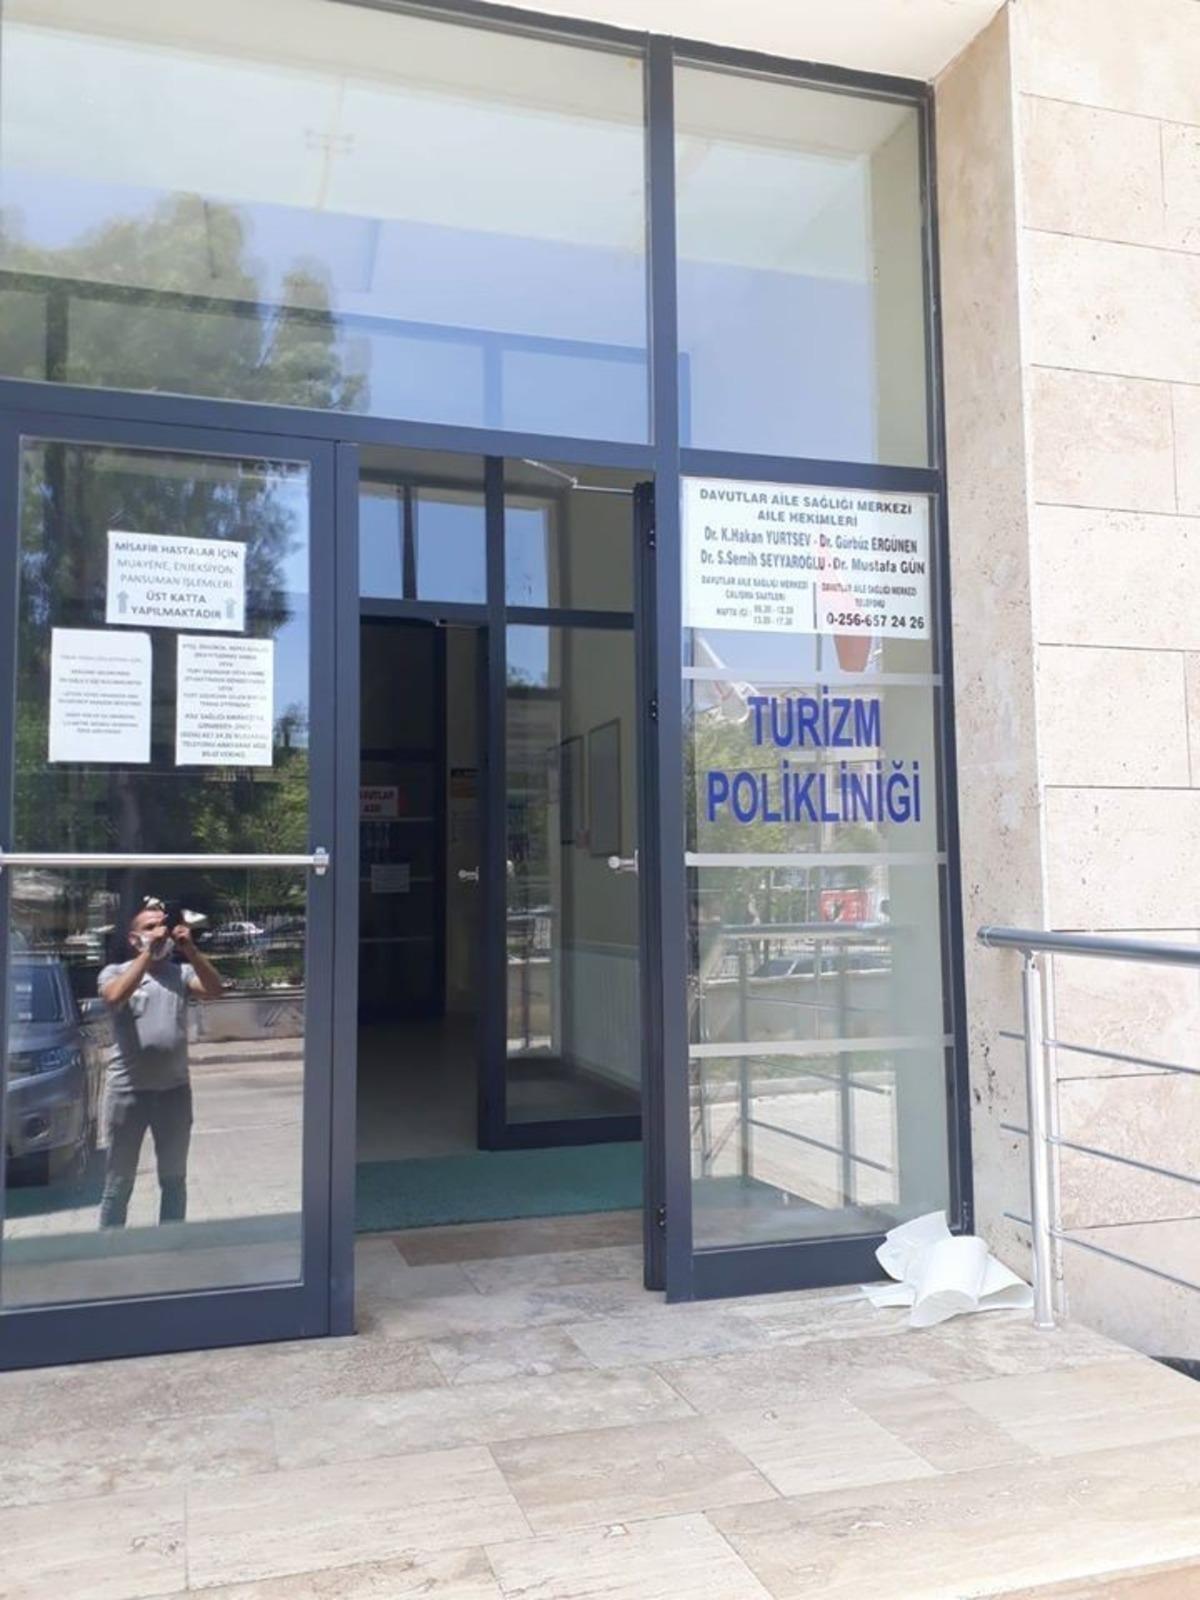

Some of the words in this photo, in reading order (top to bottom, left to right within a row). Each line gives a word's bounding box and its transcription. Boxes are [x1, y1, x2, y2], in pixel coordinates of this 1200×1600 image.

[700, 488, 767, 504] DAVUTLAR
[771, 490, 799, 506] AİLE
[804, 493, 854, 510] SAĞLIĞI
[757, 509, 784, 522] AİLE
[789, 511, 858, 527] HEKİMLERİ
[115, 540, 158, 552] MİSAFİR
[161, 545, 215, 557] HASTALAR
[218, 547, 239, 560] İÇİN
[705, 526, 718, 541] Dr.
[721, 527, 763, 544] K.Hakan
[766, 529, 811, 547] YURTSEV
[819, 533, 833, 549] Dr.
[835, 533, 870, 551] Gürbüz
[871, 534, 918, 554] ERGÜNEN
[701, 549, 714, 564] Dr.
[717, 550, 758, 567] S.Semih
[760, 550, 825, 571] SEYYAROĞLU
[833, 557, 847, 571] Dr.
[851, 559, 897, 574] Mustafa
[900, 556, 926, 575] GÜN
[120, 573, 180, 585] PANSUMAN
[146, 588, 167, 601] ÜST
[170, 593, 207, 604] KATTA
[131, 606, 221, 620] YAPILMAKTADIR
[826, 611, 887, 627] 0-256-657
[891, 614, 906, 628] 24
[909, 616, 925, 629] 26
[747, 685, 881, 748] TURİZM
[707, 759, 921, 823] POLİKLİNİĞİ
